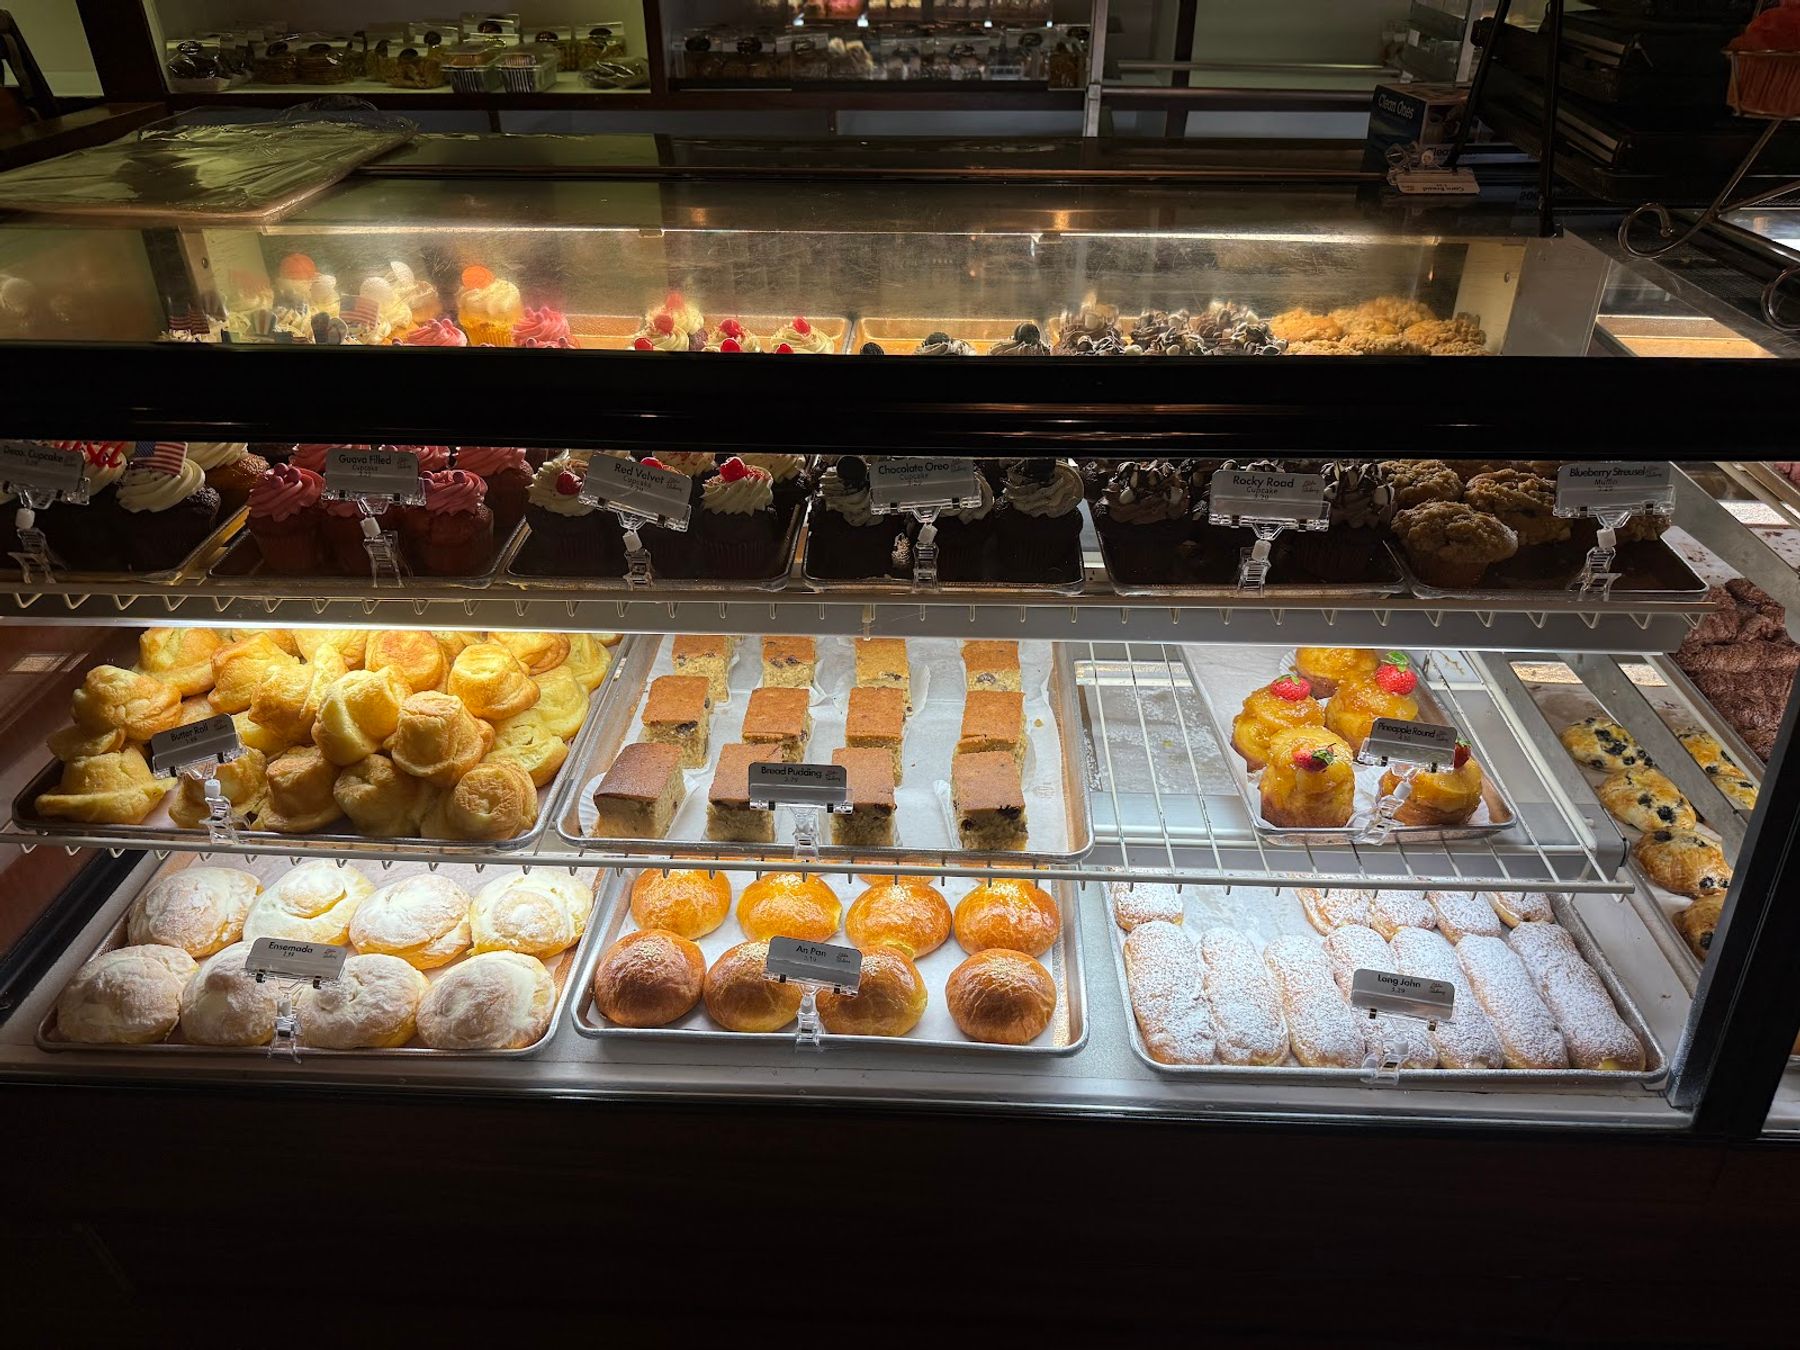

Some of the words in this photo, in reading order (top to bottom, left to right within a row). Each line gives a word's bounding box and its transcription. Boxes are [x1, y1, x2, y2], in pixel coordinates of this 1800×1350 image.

[28, 449, 64, 463] Cupcake
[338, 454, 367, 464] Guava
[370, 454, 391, 465] Filled
[614, 463, 634, 476] Red
[635, 467, 664, 484] Velvet
[878, 462, 924, 475] Chocolate
[924, 461, 949, 472] Oreo
[1569, 466, 1612, 479] Blueberry
[1232, 475, 1264, 488] Rocky
[1266, 476, 1295, 488] Road
[170, 730, 192, 742] Butter
[193, 721, 208, 735] Roll
[1411, 726, 1436, 738] Round
[761, 766, 786, 776] Bread
[787, 766, 822, 779] Pudding
[795, 945, 808, 955] An
[809, 947, 826, 957] Pan
[1377, 974, 1399, 986] Long
[1399, 978, 1421, 988] John
